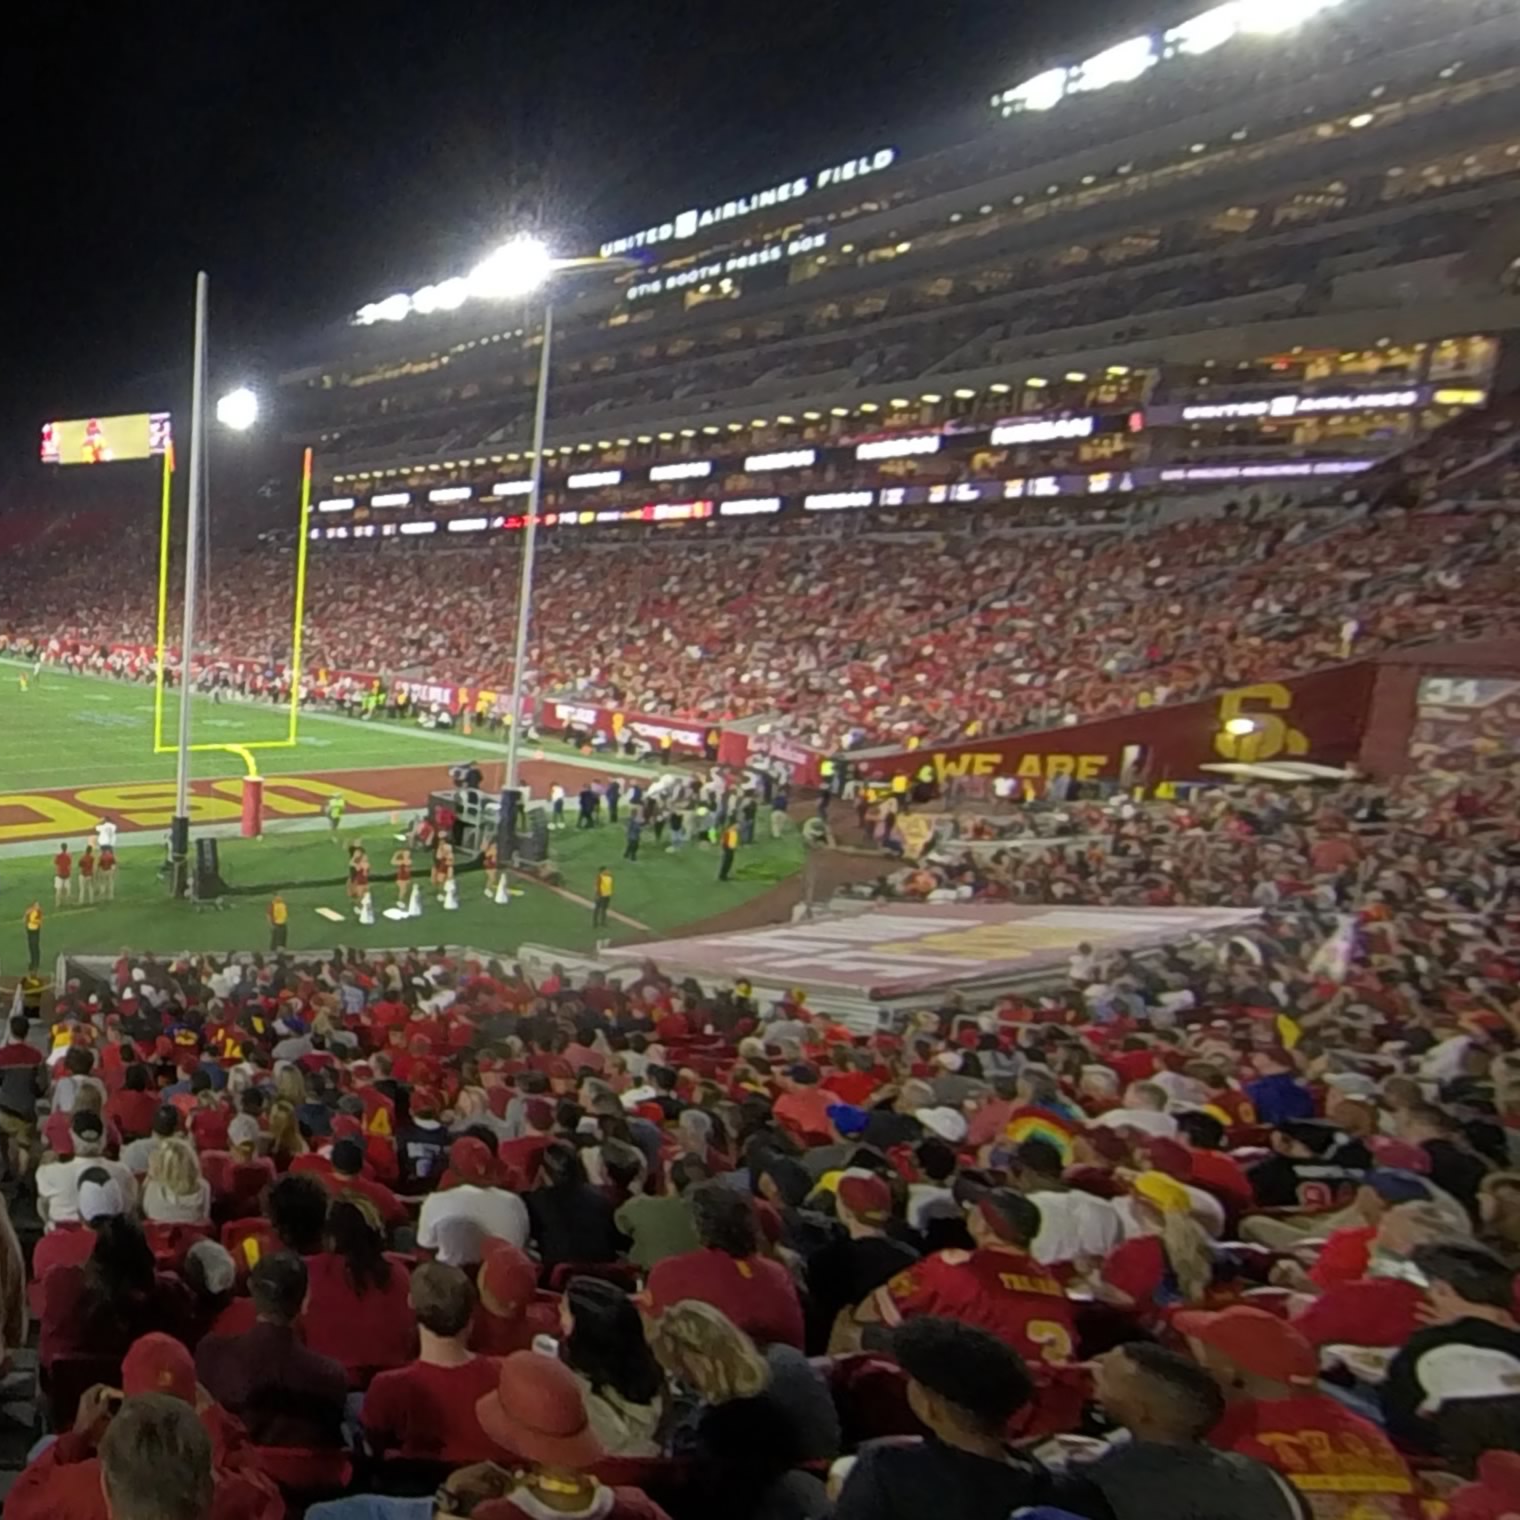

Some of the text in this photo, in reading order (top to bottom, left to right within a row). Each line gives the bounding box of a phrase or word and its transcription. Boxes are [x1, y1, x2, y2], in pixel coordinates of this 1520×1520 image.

[600, 148, 895, 258] UNITED AIRLINES FIELD
[627, 232, 828, 300] OTIS BOOTH PRESS BOX
[1182, 401, 1268, 419] UNITED
[1296, 390, 1418, 411] AIRLINES
[1424, 677, 1480, 703] 34
[933, 753, 1109, 783] WE ARE
